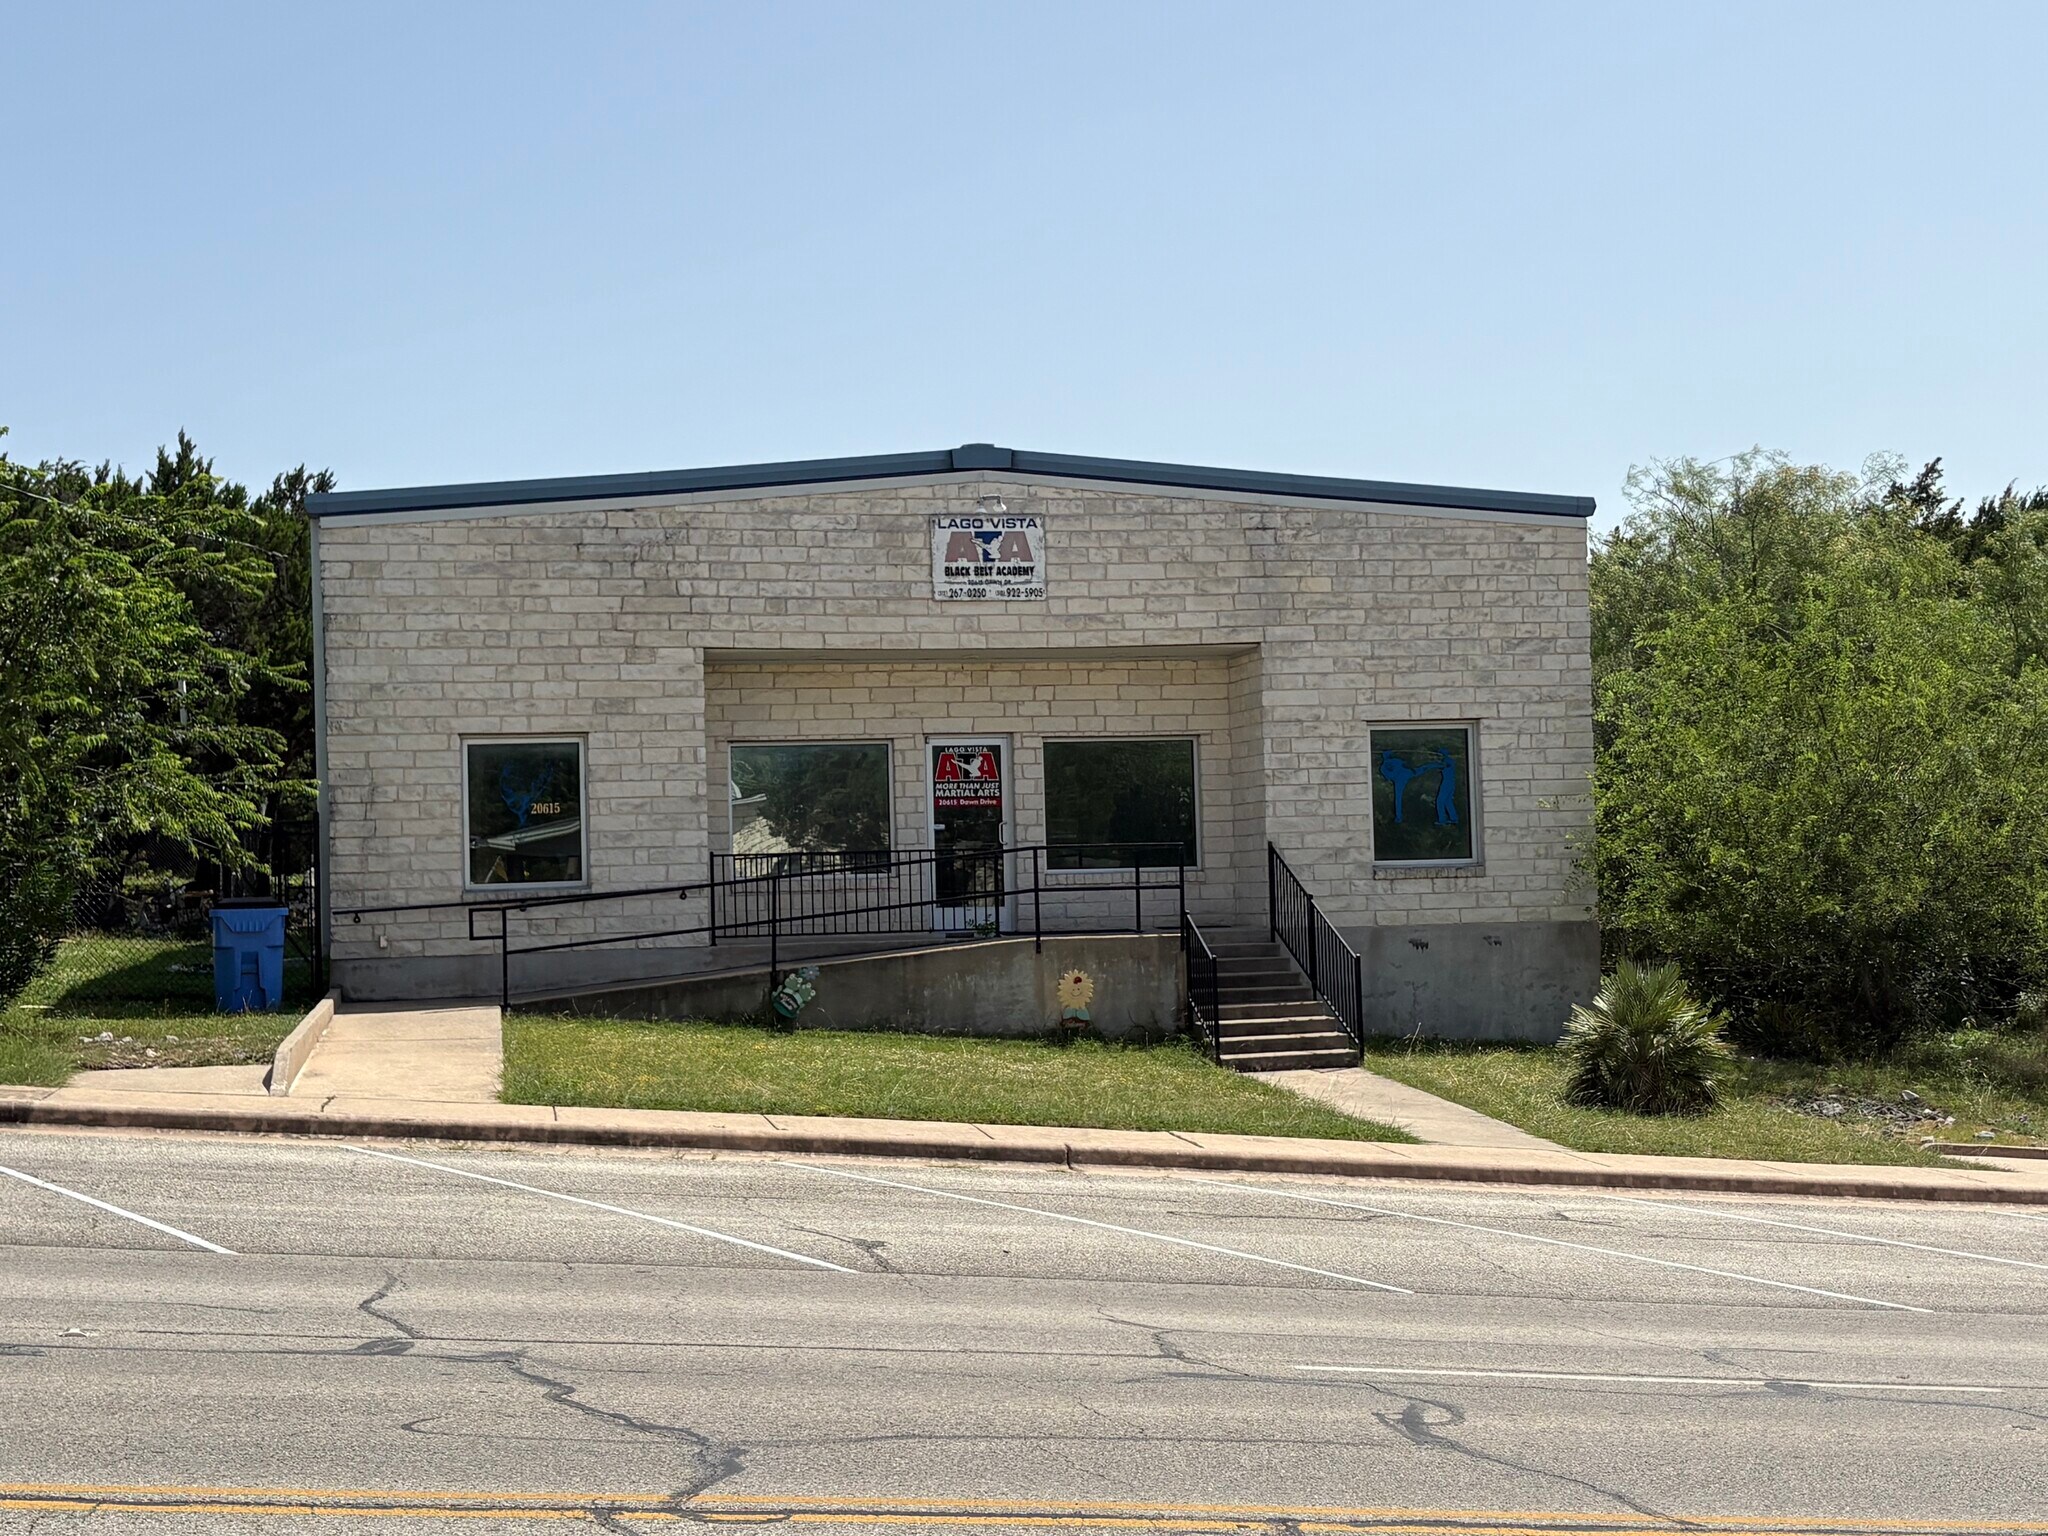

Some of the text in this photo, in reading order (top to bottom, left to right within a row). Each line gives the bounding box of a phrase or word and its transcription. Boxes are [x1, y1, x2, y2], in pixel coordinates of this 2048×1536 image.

[937, 518, 1038, 529] LAGO VISTA
[944, 531, 1034, 563] ATA
[944, 565, 1035, 577] BLACK BELT ACADEMY
[948, 588, 987, 598] 267-0250
[1006, 588, 1043, 598] 922-5905
[935, 752, 999, 781] ATA
[935, 789, 1000, 797] MARTIAL ARTS
[531, 803, 560, 814] 20615
